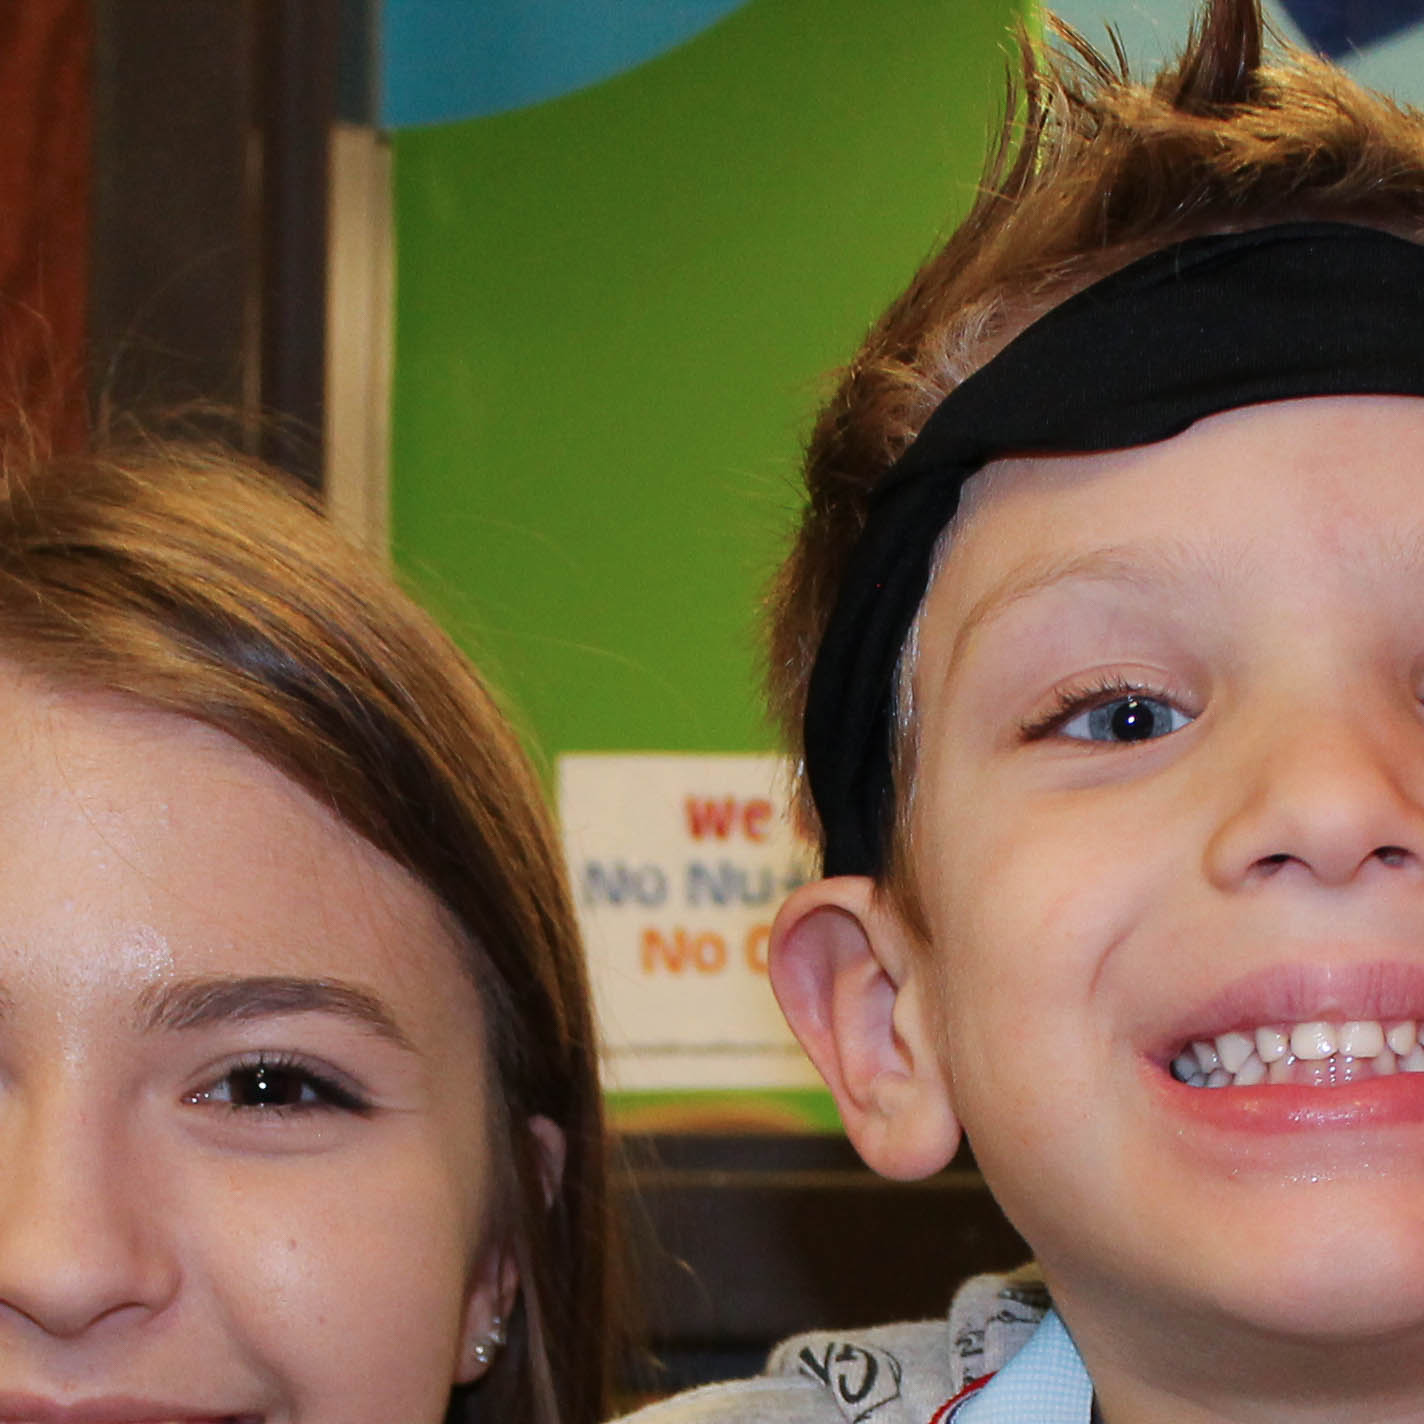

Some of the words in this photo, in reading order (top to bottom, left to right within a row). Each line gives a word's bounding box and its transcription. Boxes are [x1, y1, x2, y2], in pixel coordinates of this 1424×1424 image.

[684, 796, 773, 842] We
[583, 861, 669, 908] No
[641, 928, 727, 976] No
